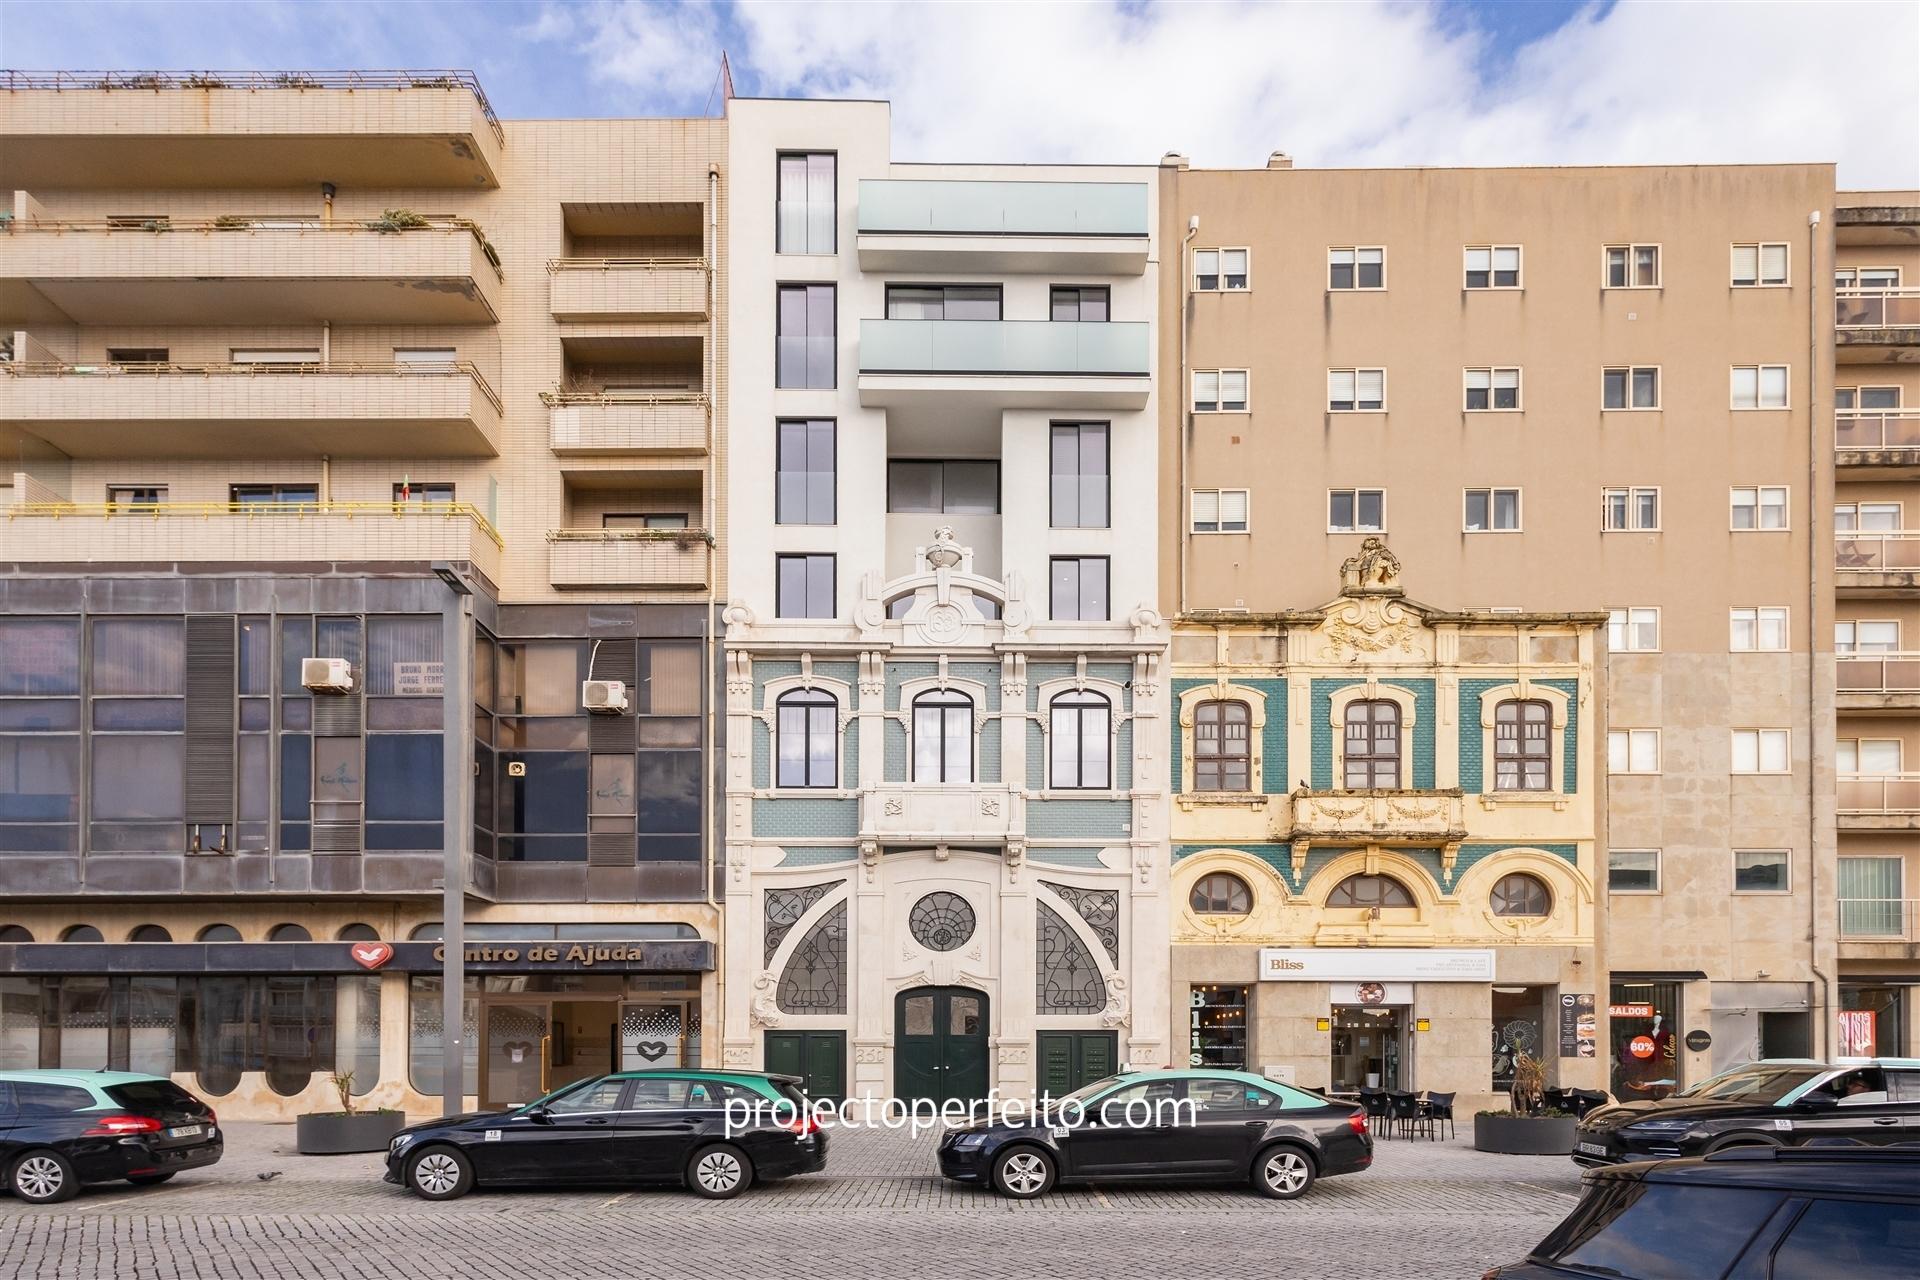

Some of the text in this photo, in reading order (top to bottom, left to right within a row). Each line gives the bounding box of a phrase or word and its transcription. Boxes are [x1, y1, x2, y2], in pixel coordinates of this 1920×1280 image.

[401, 665, 421, 673] BRUNO
[399, 675, 419, 684] JORGE
[433, 945, 642, 966] Cntro de Ajuda
[1270, 959, 1304, 970] Bliss
[1609, 1006, 1648, 1016] SALDOS
[1630, 1041, 1655, 1052] 60%
